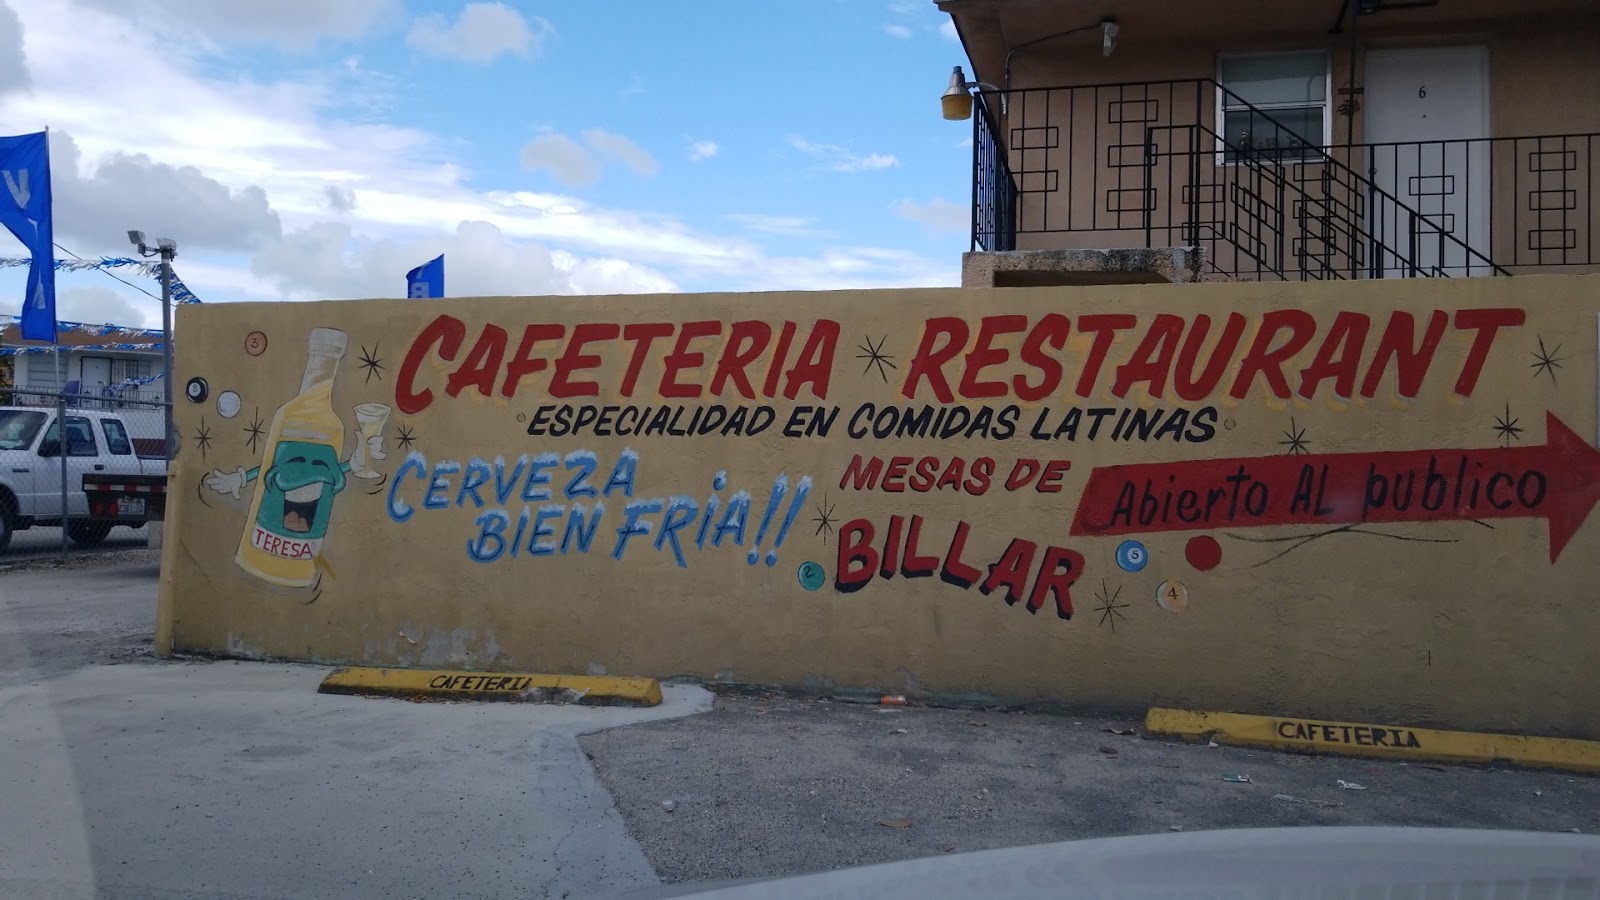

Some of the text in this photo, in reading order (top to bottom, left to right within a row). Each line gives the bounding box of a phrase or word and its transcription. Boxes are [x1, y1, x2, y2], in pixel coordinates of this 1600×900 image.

[1418, 85, 1427, 99] 6
[395, 308, 1526, 414] CAFETERIA RESTAURANT
[527, 403, 1218, 443] ESPECIALIDAD EN COMIDAS LATINAS
[387, 447, 639, 523] CERVEZA
[839, 454, 1072, 496] MESAS DE
[1110, 455, 1547, 527] Abierto AL publico
[256, 529, 313, 558] TERESA
[467, 500, 606, 563] BIEN
[835, 514, 1086, 620] BILLAR
[1277, 721, 1422, 749] CAFETERIA
